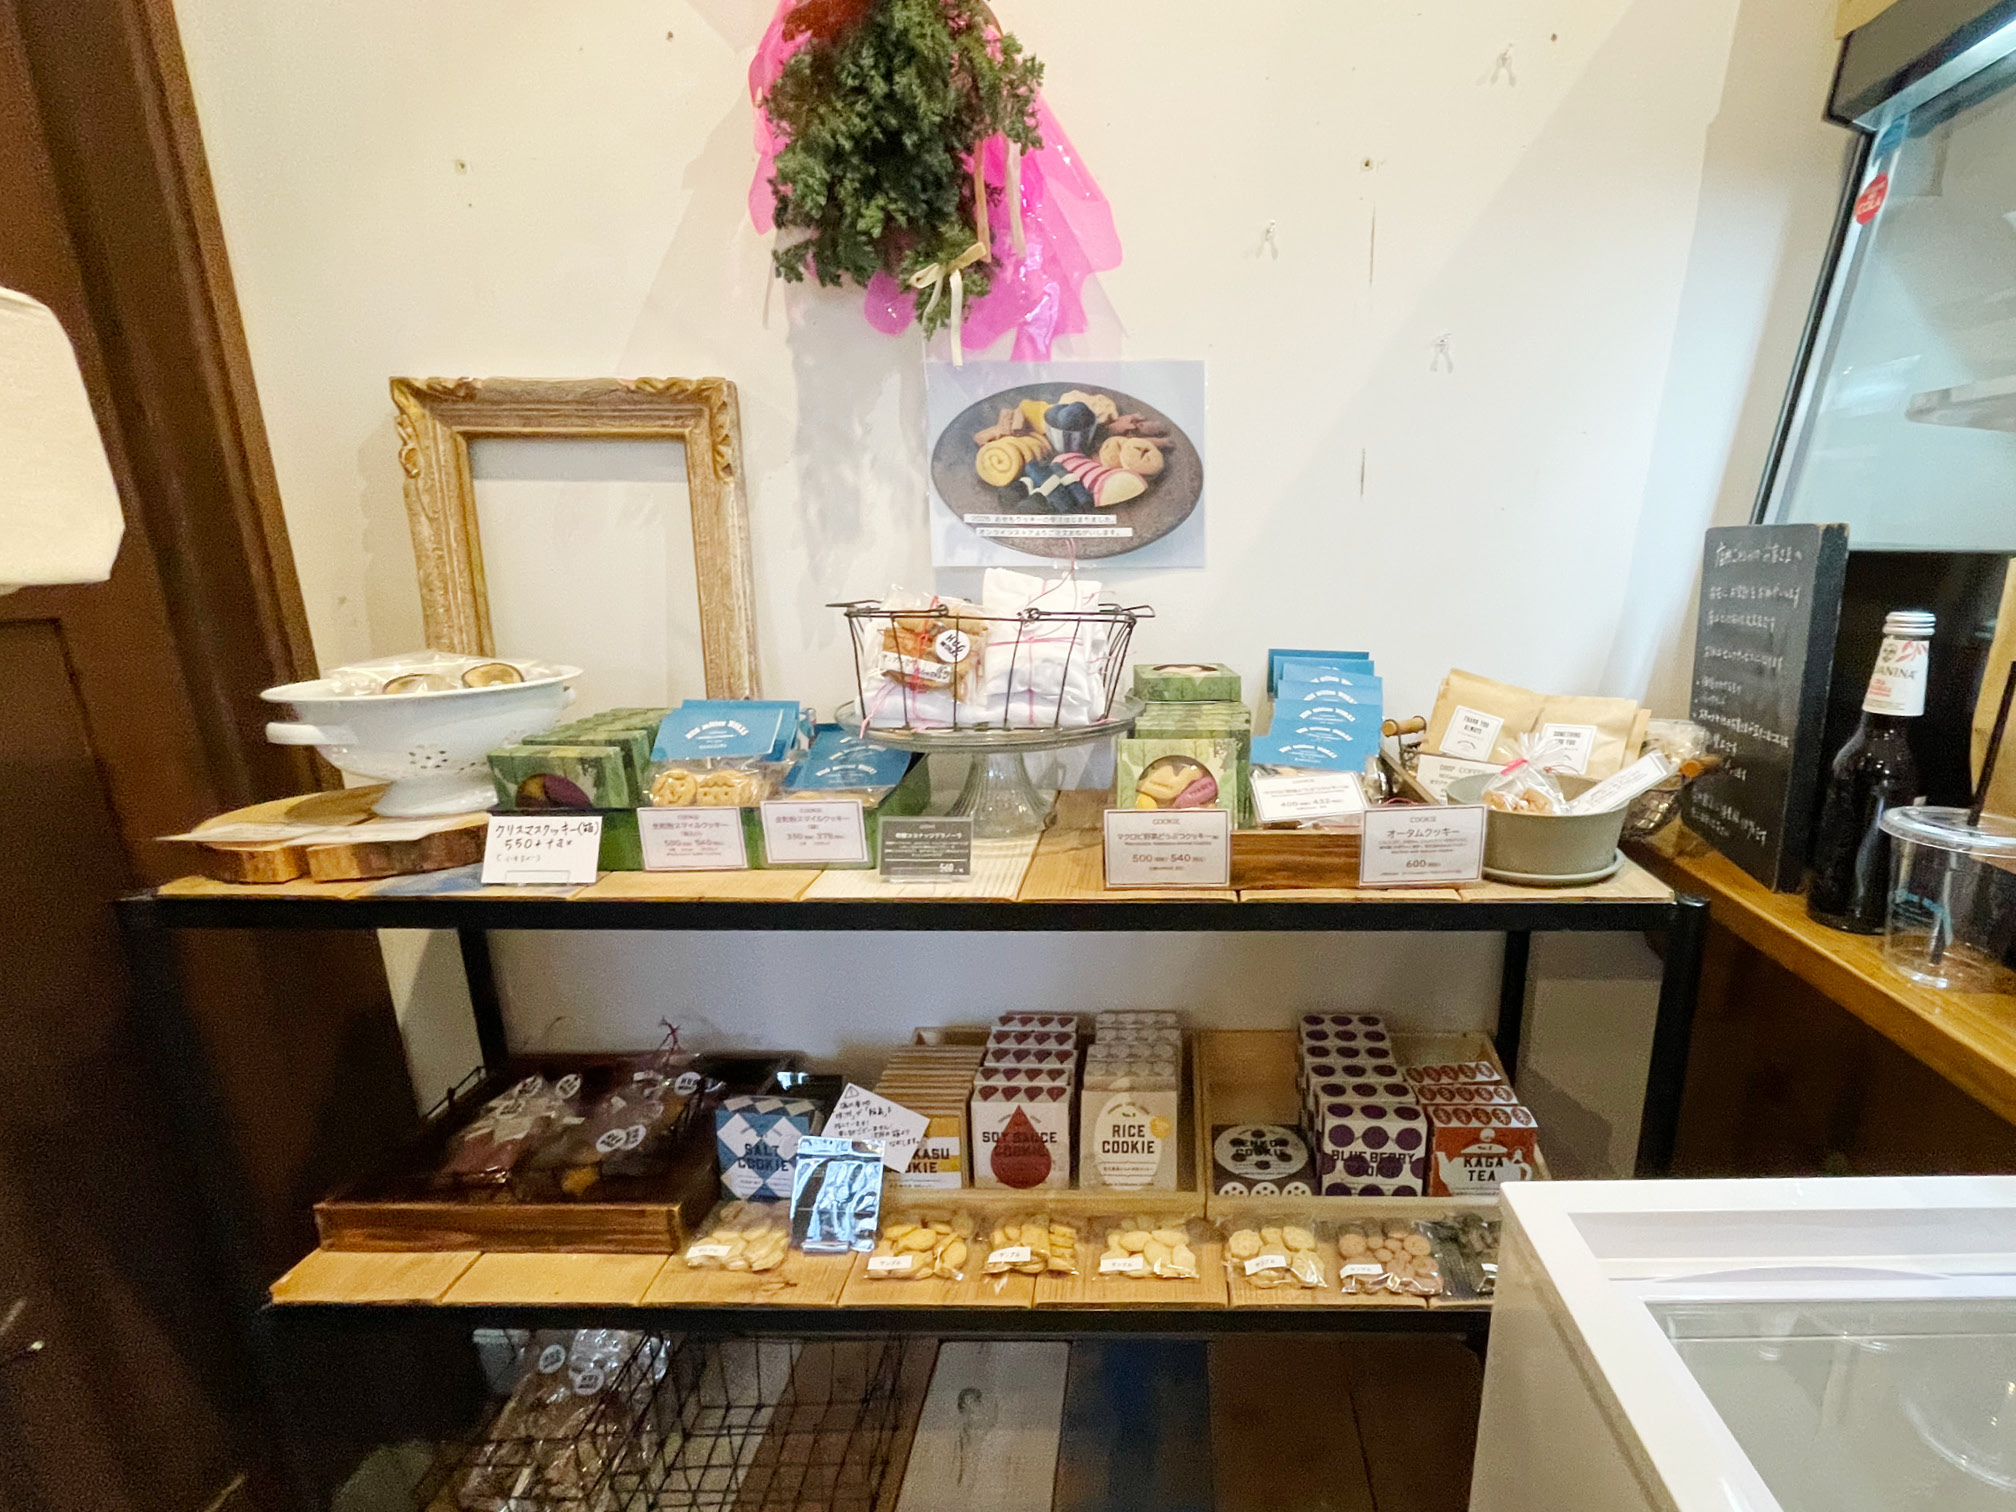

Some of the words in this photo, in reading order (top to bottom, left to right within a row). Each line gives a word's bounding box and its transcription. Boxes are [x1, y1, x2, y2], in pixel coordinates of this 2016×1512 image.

[1387, 827, 1460, 839] オータムクッキー
[1405, 859, 1427, 868] 600
[982, 1131, 1012, 1143] SOY
[1112, 1124, 1146, 1138] RICE
[745, 1143, 780, 1156] SALT
[1102, 1140, 1155, 1154] COOKIE
[738, 1157, 789, 1172] COOKIE
[1464, 1157, 1504, 1168] KAGA
[1468, 1170, 1496, 1182] TEA
